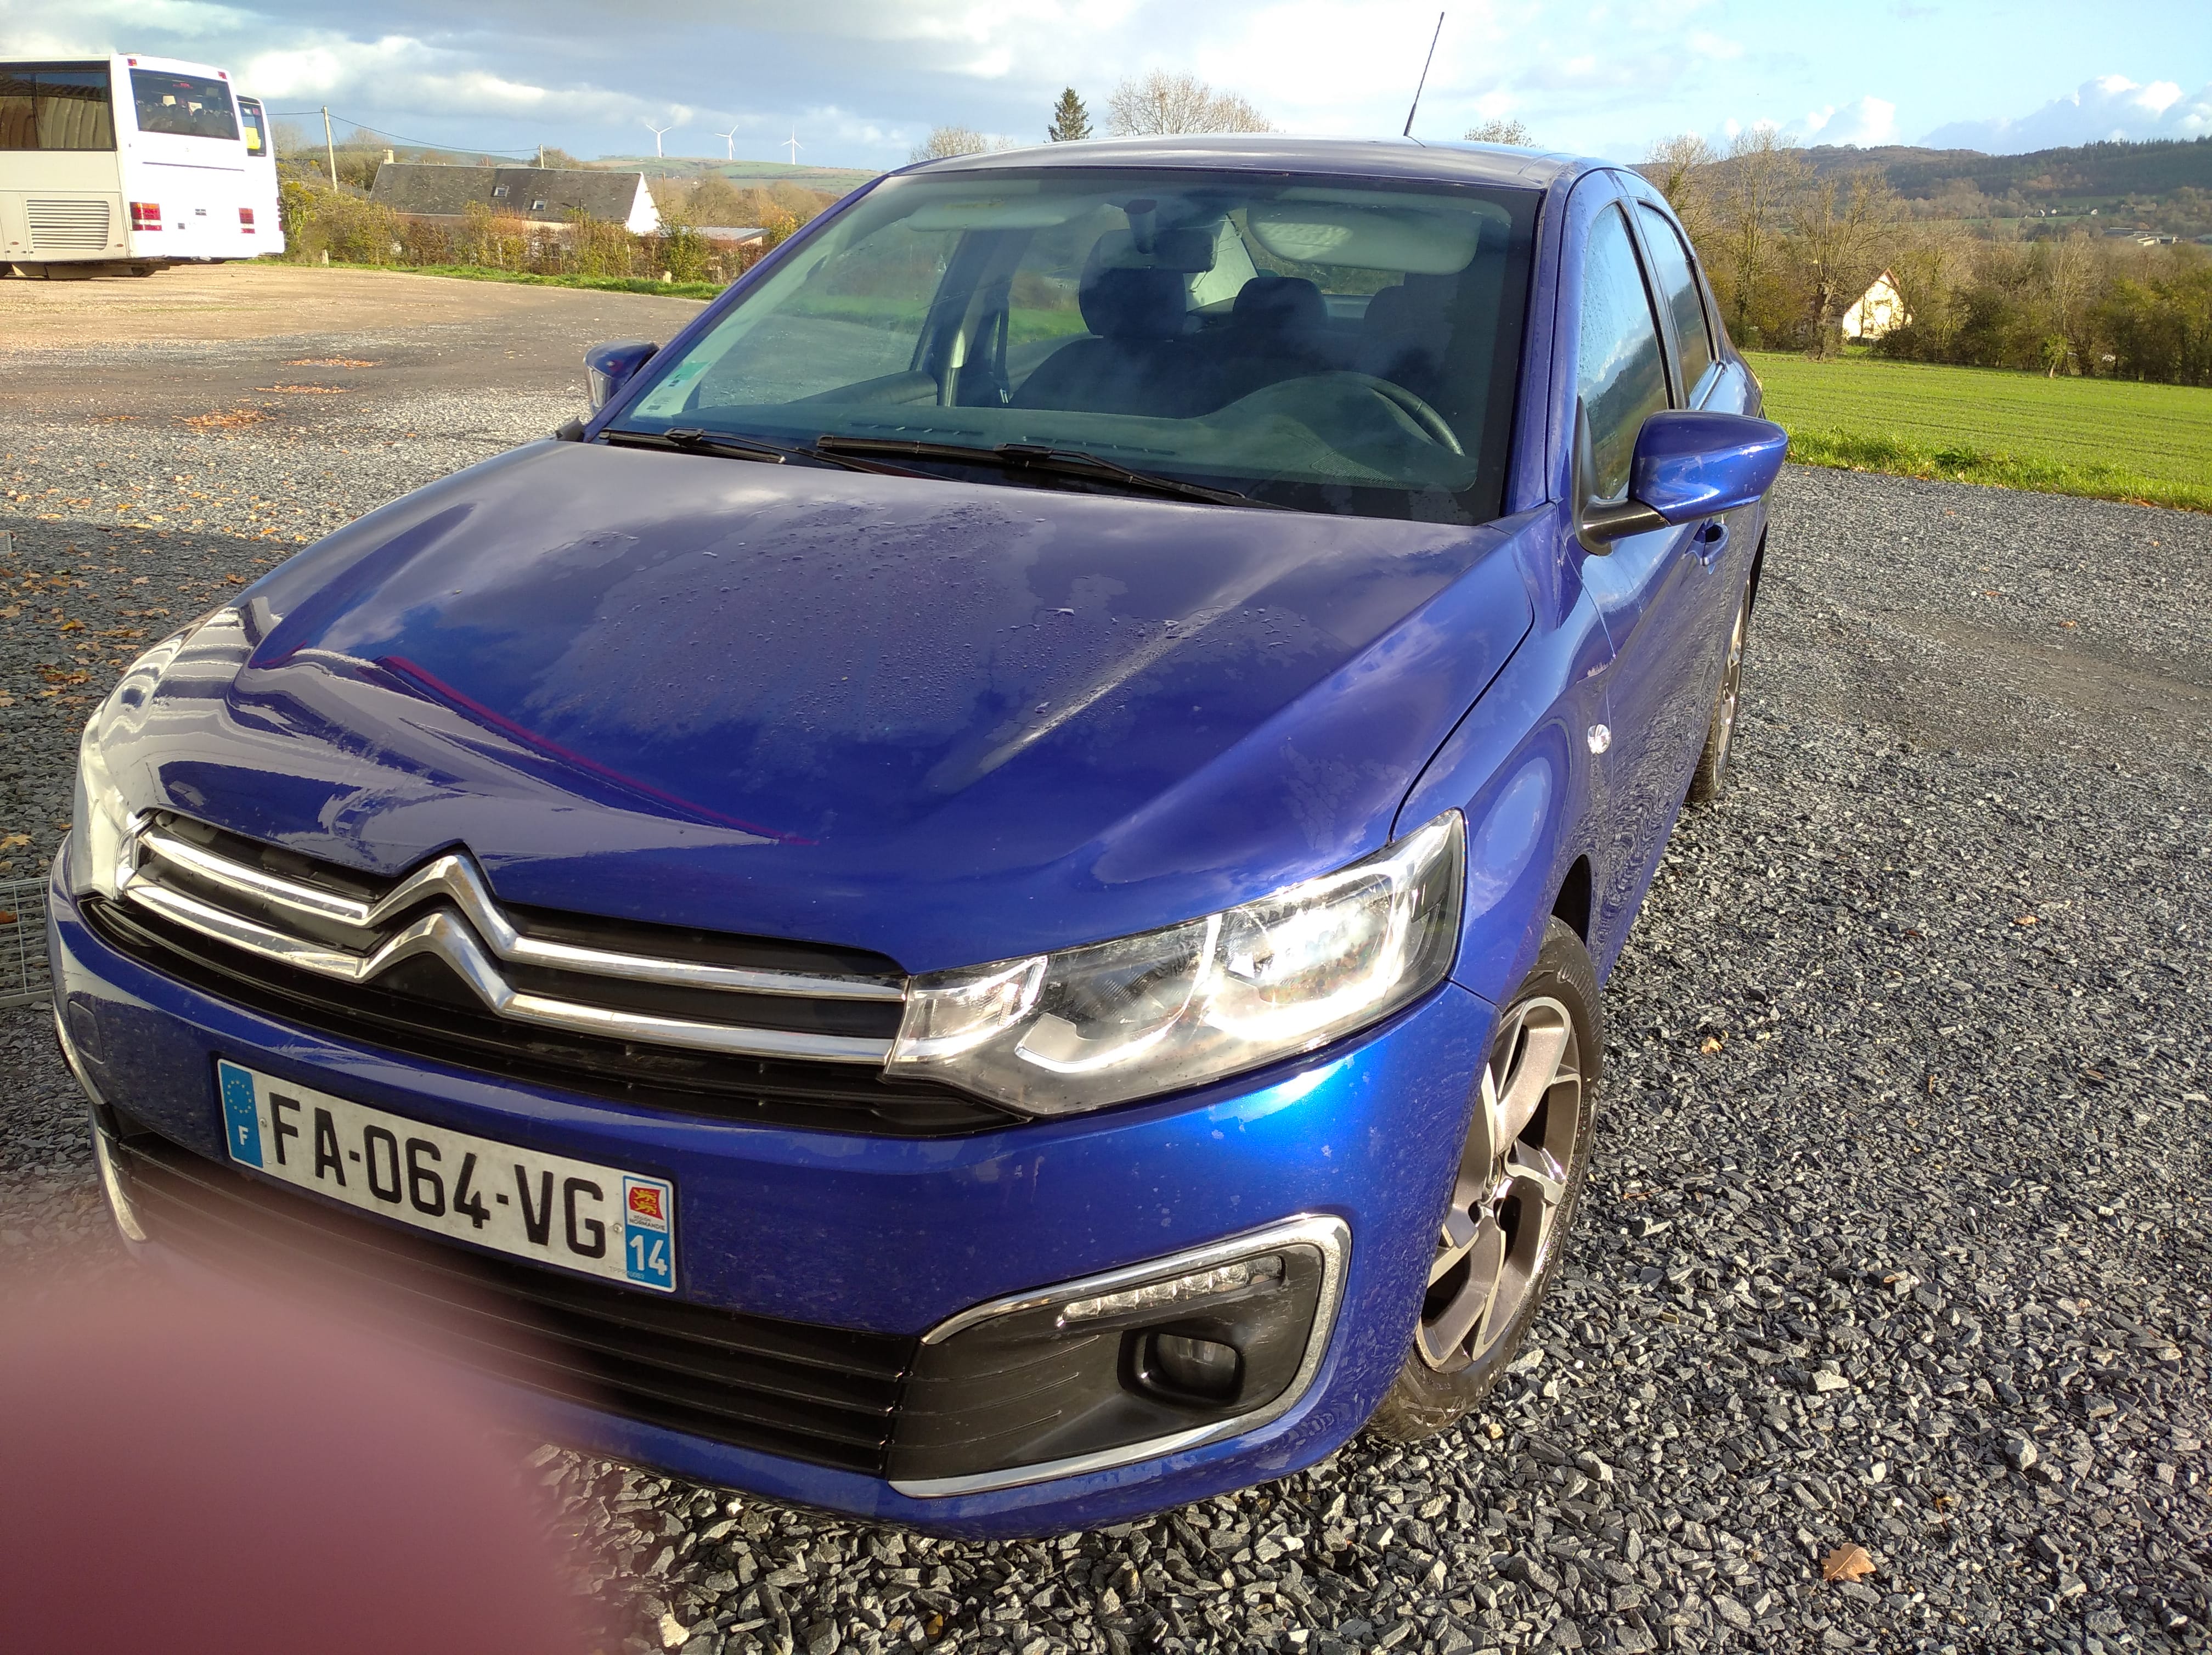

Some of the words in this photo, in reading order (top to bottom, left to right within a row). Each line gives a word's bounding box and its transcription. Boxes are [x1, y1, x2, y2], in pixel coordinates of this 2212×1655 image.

[238, 1125, 249, 1146] F
[269, 1092, 606, 1259] FA-064-VG
[629, 1218, 665, 1231] NORMANDIE
[629, 1235, 668, 1276] 14
